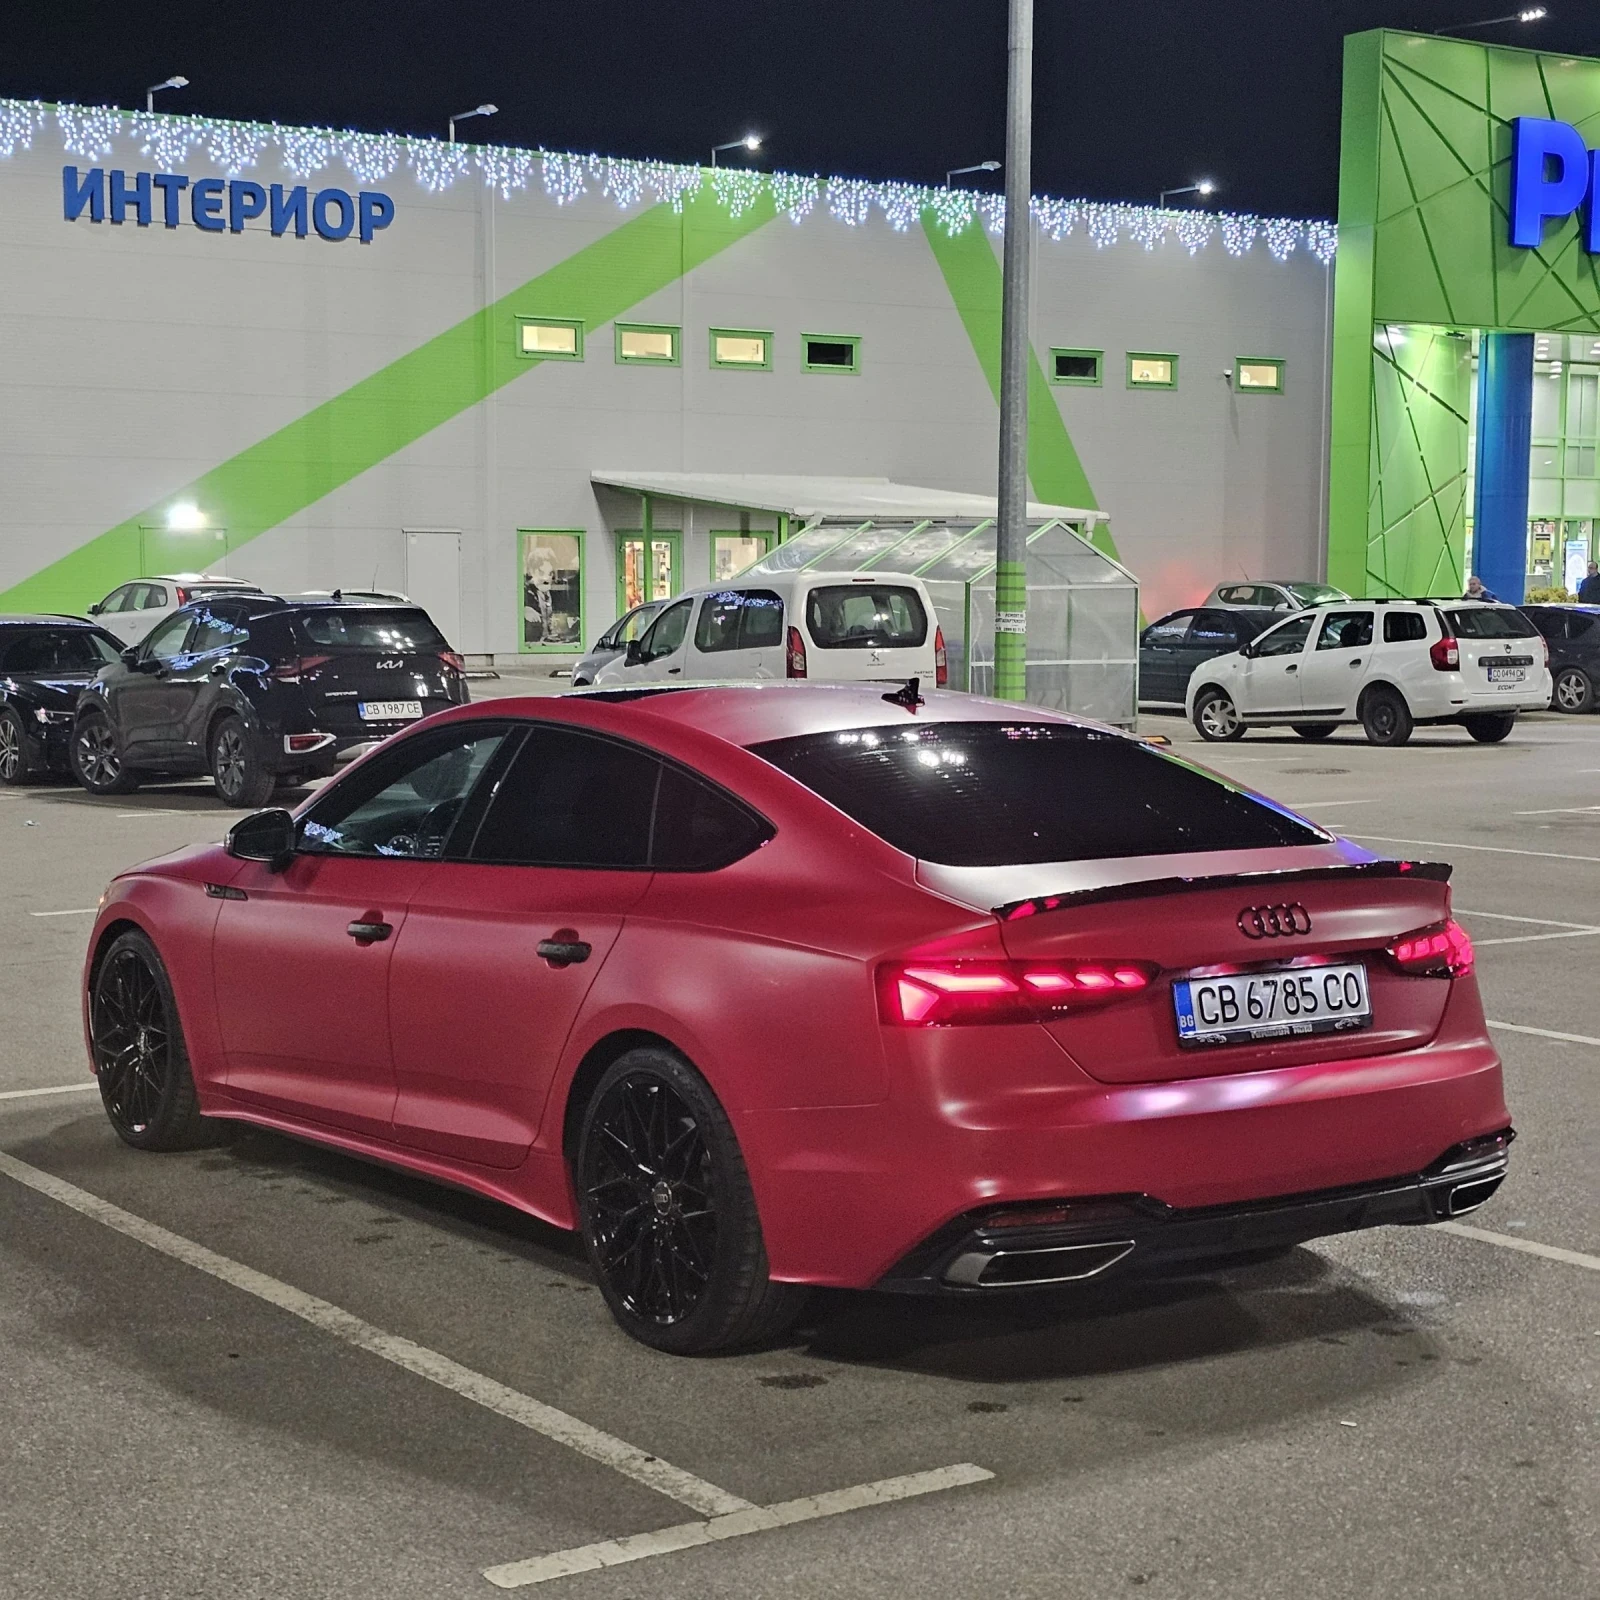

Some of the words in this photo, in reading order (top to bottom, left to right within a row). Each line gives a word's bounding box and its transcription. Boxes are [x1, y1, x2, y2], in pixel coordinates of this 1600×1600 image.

[63, 165, 395, 244] ИНТЕРИОР
[366, 704, 380, 715] CB
[382, 703, 405, 715] 1987
[407, 702, 421, 714] CE
[1198, 985, 1240, 1025] CB
[1247, 976, 1319, 1020] 6785
[1323, 972, 1361, 1011] CO
[1180, 1015, 1195, 1028] BG
